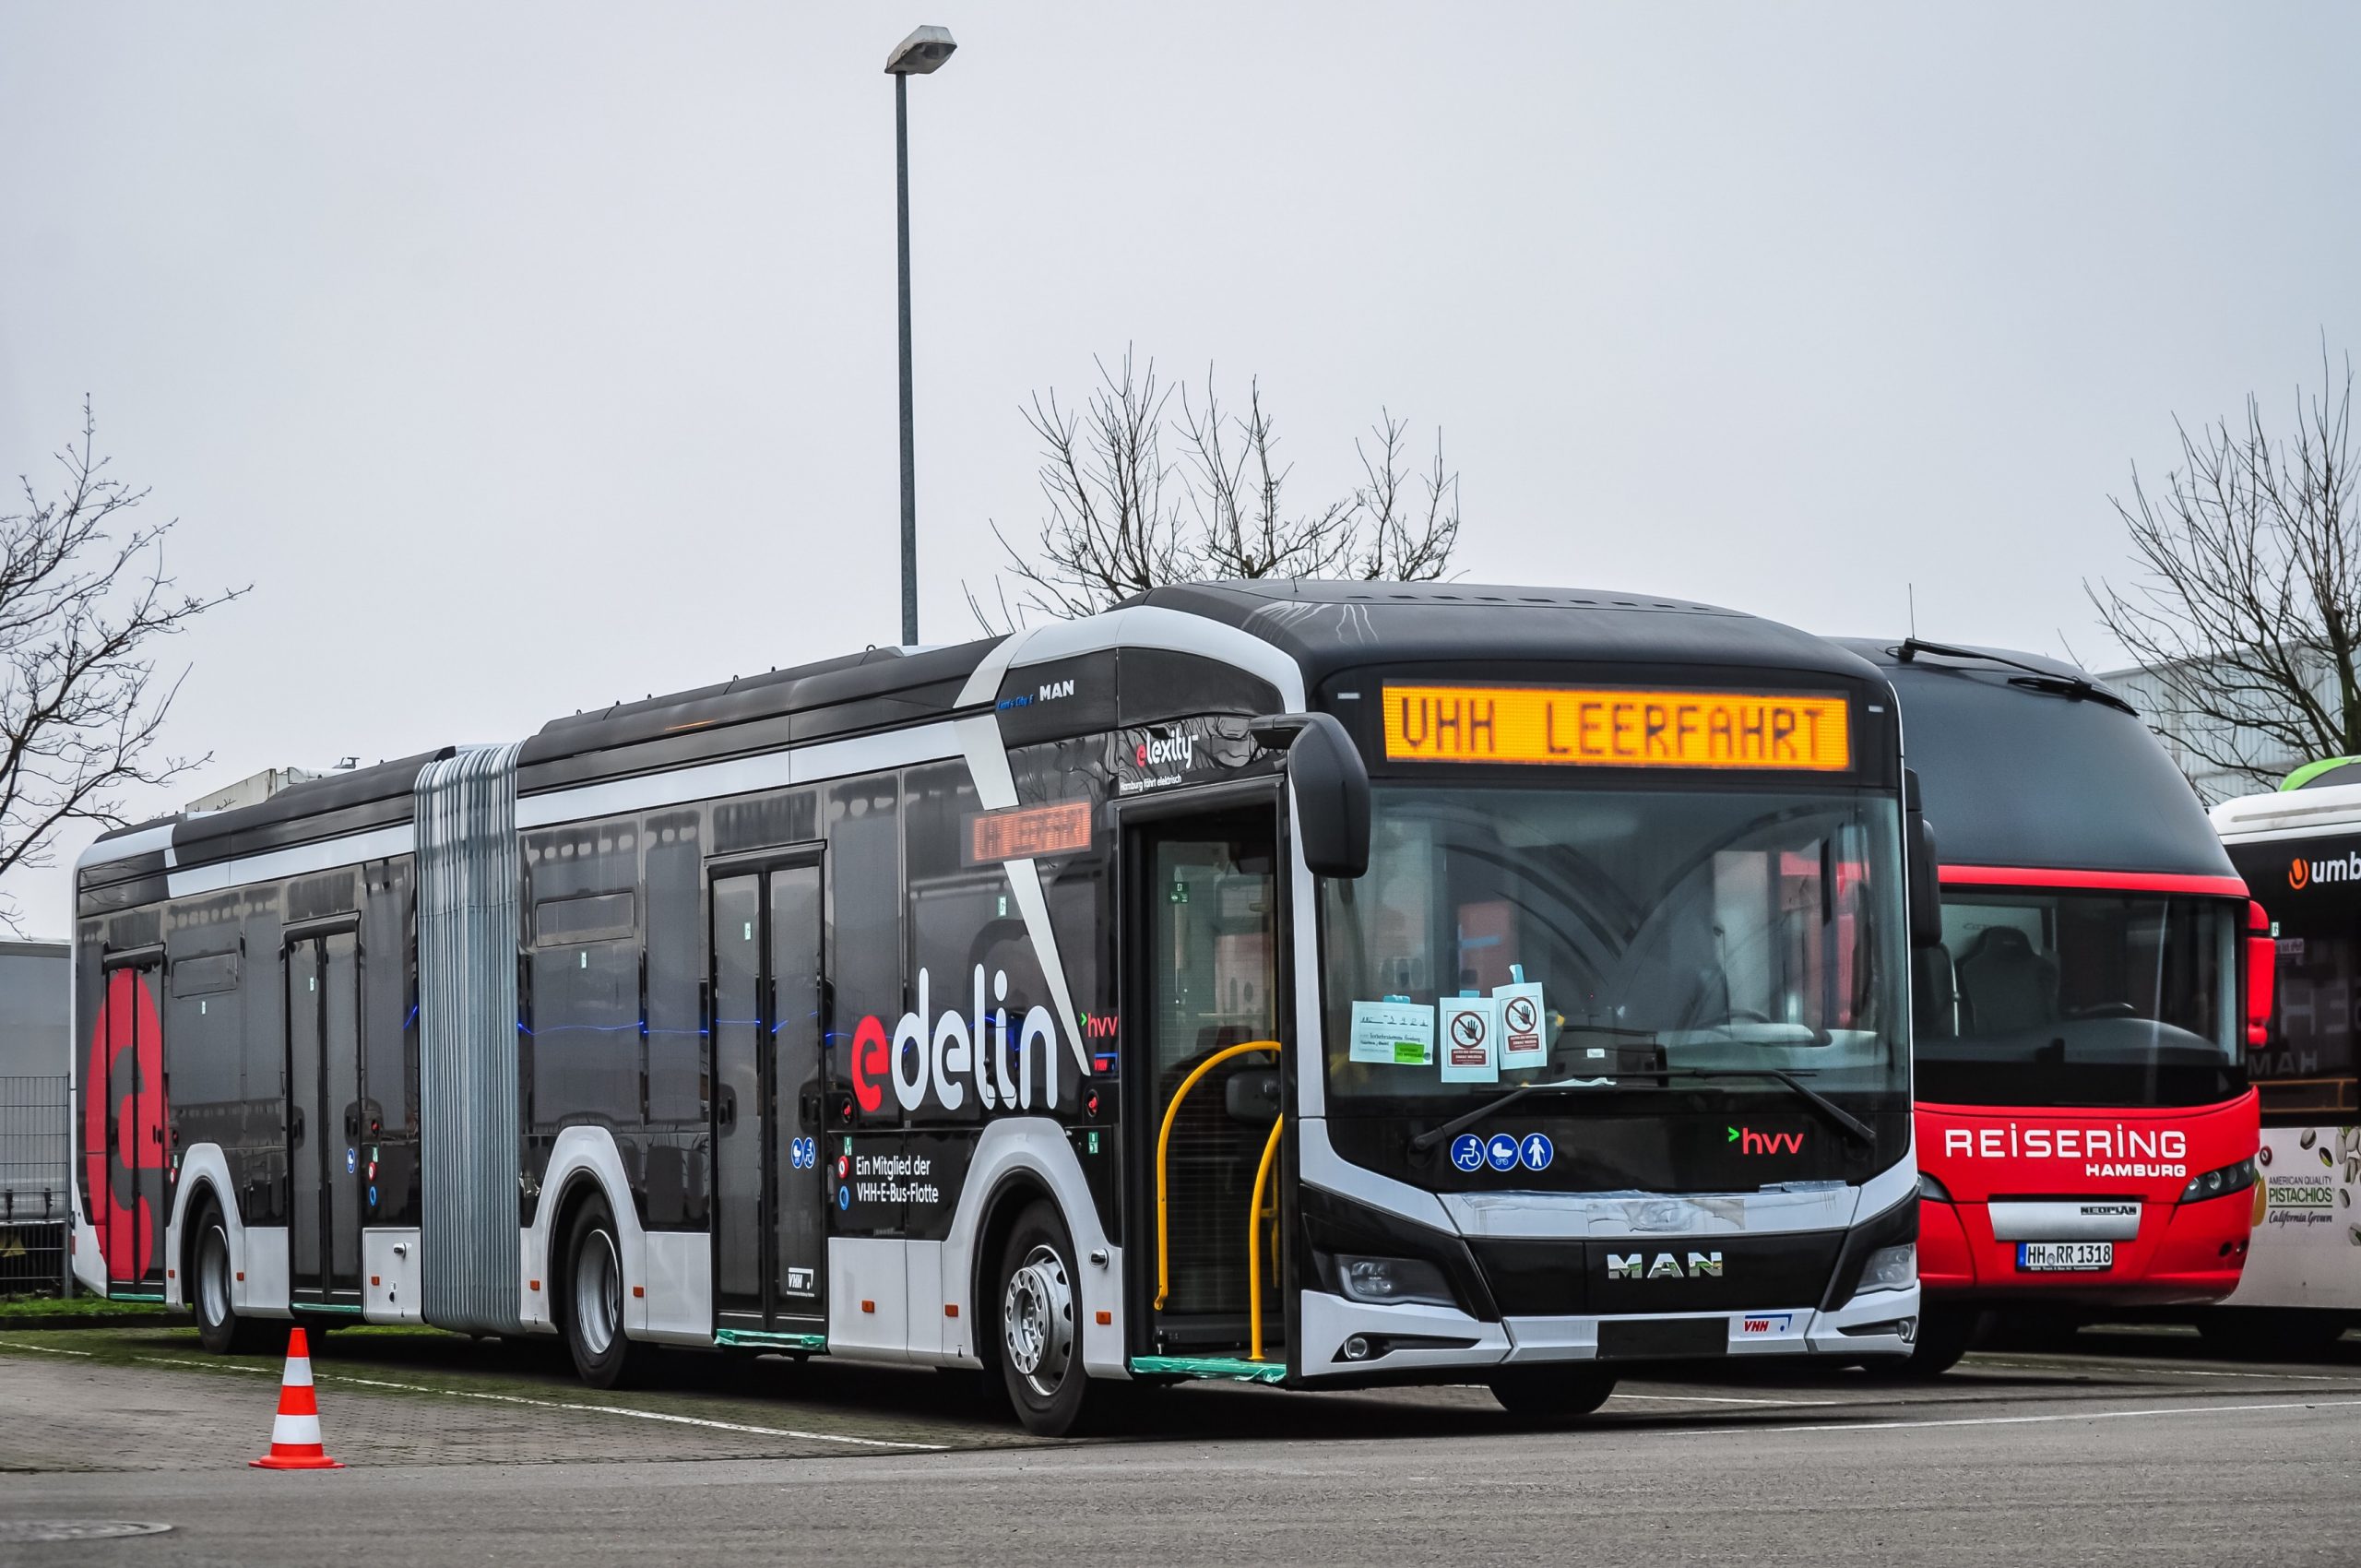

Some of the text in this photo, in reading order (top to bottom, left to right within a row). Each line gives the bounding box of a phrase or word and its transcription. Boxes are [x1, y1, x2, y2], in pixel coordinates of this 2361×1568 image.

[1039, 679, 1074, 702] MAN
[1400, 695, 1825, 762] VHH LEERFAHRT
[1135, 727, 1193, 769] elexity
[1120, 778, 1144, 792] Hamburg
[1157, 774, 1182, 787] elektrisch
[1087, 1012, 1119, 1039] hvv
[851, 962, 1058, 1112] edelin
[1741, 1126, 1805, 1156] hvv
[856, 1154, 931, 1182] Ein Mitglied der
[2085, 1162, 2187, 1178] HAMBURG
[2269, 1175, 2332, 1186] AMERICAN QUALITY
[856, 1182, 940, 1204] VHH-E-Bus-Flotte
[2269, 1187, 2333, 1203] PISTACHIOS
[2080, 1206, 2137, 1216] NEOPLAN
[2269, 1209, 2332, 1229] California Grown
[1607, 1250, 1724, 1280] MAN
[2027, 1245, 2047, 1265] HH
[2056, 1245, 2075, 1265] RR
[2077, 1244, 2112, 1264] 1318
[1743, 1318, 1770, 1334] VHH
